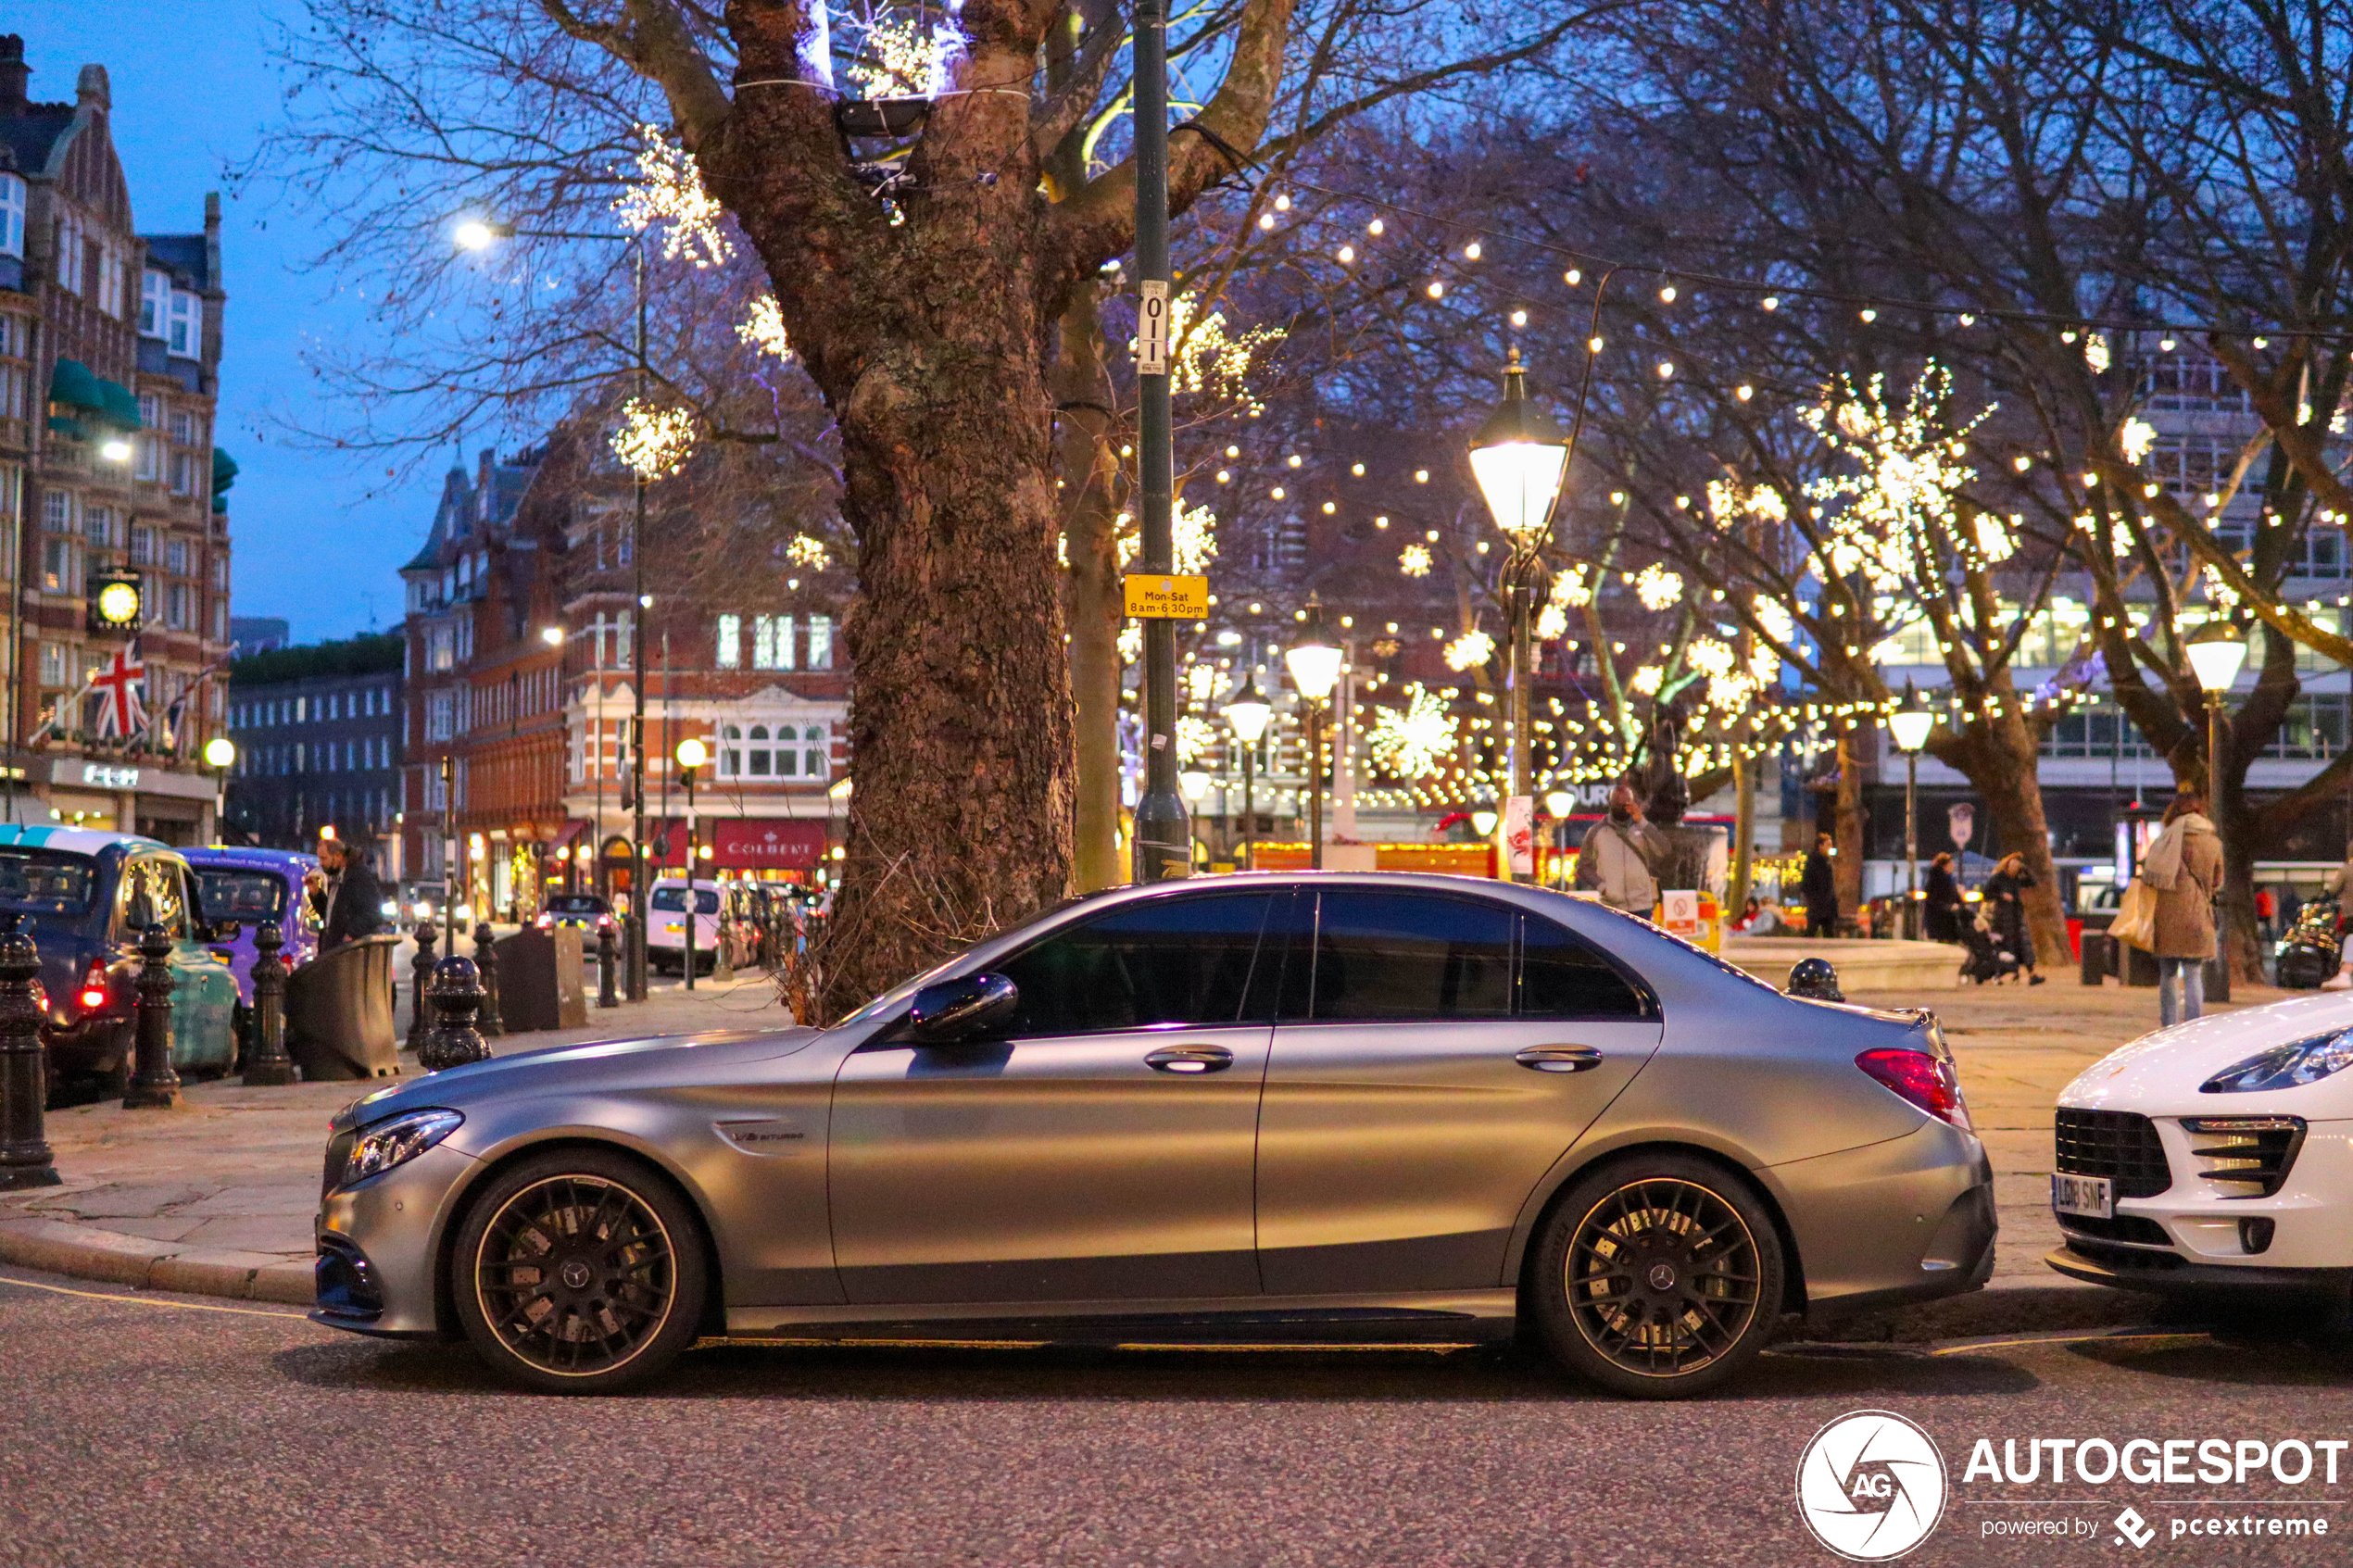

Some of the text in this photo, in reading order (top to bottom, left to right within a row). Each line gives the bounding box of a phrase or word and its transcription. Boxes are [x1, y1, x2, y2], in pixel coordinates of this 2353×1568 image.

[1145, 592, 1189, 601] Mon-Sat
[728, 841, 810, 855] COLBERT
[732, 1132, 804, 1141] V8 BITURBO
[2082, 1180, 2106, 1210] SNF
